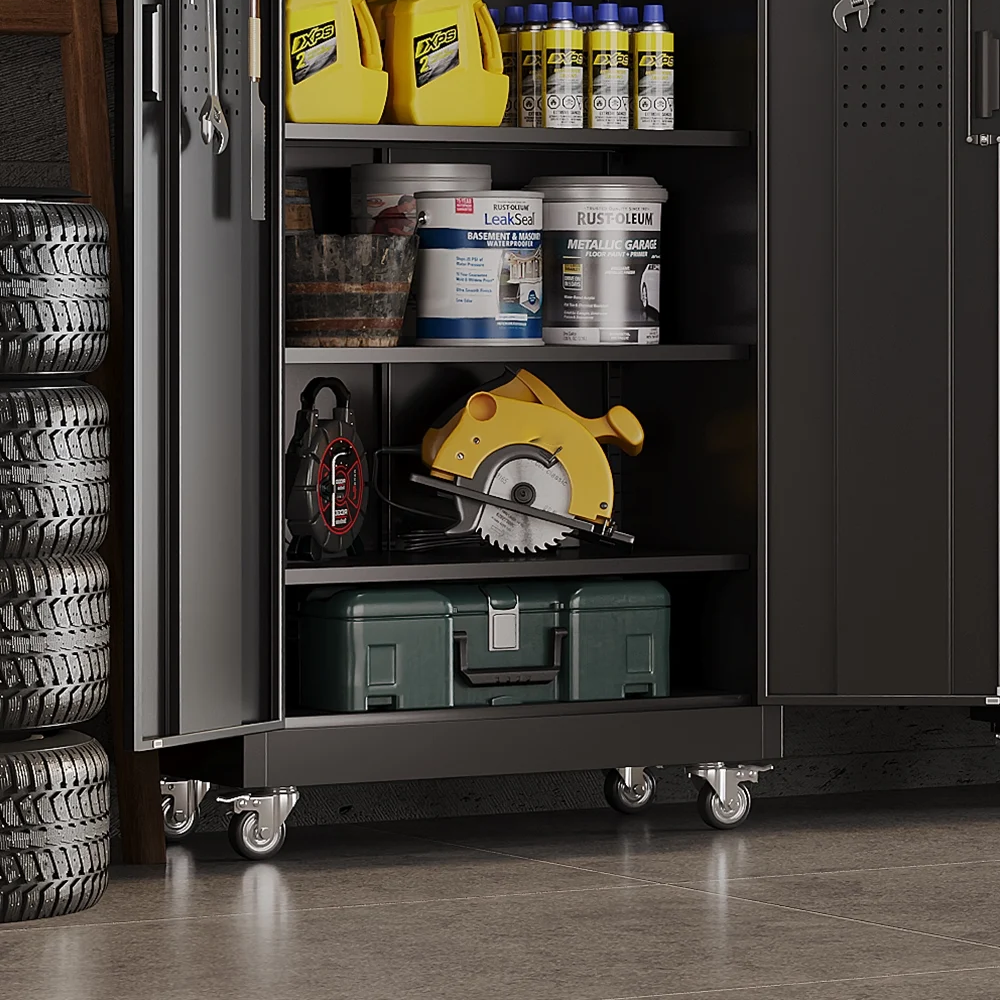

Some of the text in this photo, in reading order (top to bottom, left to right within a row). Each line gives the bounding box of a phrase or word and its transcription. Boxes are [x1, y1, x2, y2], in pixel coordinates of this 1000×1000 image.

[299, 25, 334, 50] XPS
[423, 29, 457, 53] XPS
[296, 52, 306, 70] 2
[420, 56, 429, 73] 2
[484, 212, 536, 226] LeakSeal
[577, 212, 653, 226] RUST-OLEUM
[467, 231, 510, 241] BASEMENT
[512, 232, 518, 240] &
[567, 239, 657, 250] METALLIC GARAGE
